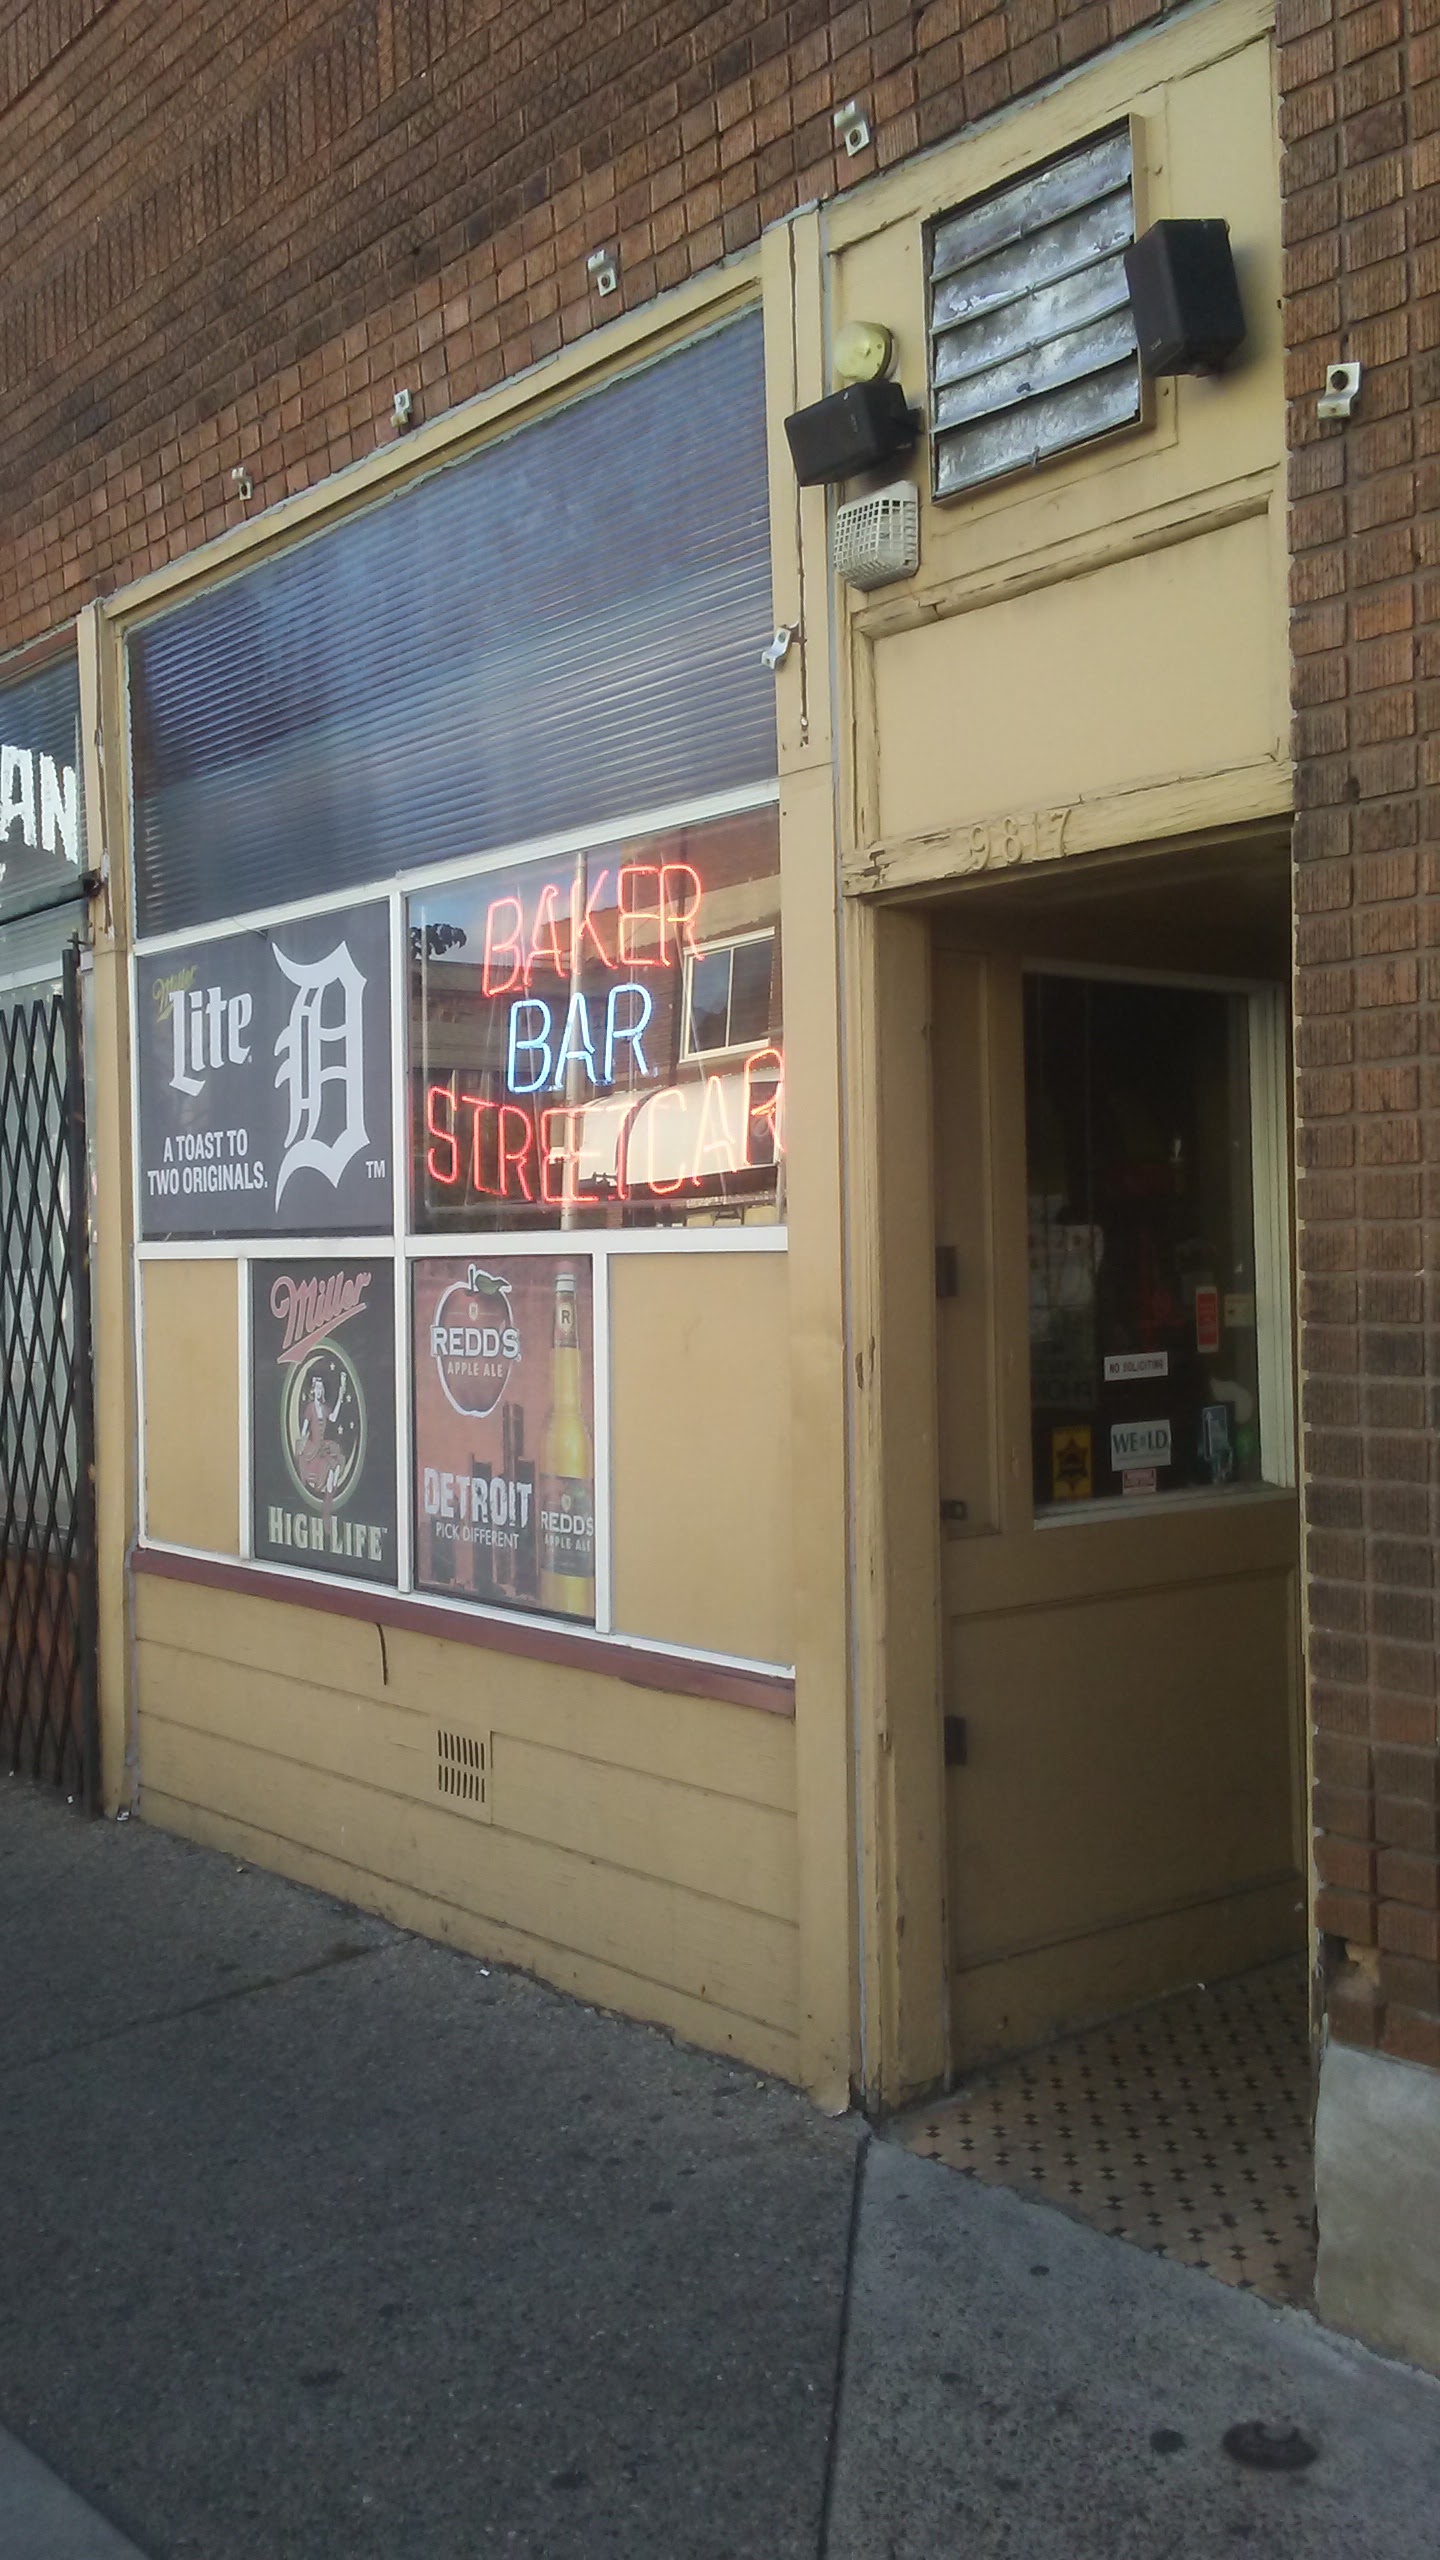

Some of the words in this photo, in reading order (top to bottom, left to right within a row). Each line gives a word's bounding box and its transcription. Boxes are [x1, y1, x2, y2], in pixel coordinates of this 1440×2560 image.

[968, 808, 1072, 871] 9817
[482, 863, 706, 997] BAKER
[168, 986, 253, 1097] Lite
[506, 982, 655, 1093] BAR
[427, 1047, 785, 1203] STREETCAR
[163, 1136, 174, 1163] A
[175, 1131, 224, 1161] TOAST
[226, 1128, 248, 1157] TO
[147, 1168, 179, 1195] TWO
[182, 1160, 268, 1194] ORIGINALS.
[366, 1160, 386, 1178] TM
[270, 1270, 372, 1350] Miller
[561, 1310, 571, 1324] R
[447, 1361, 479, 1377] APPLE
[483, 1363, 503, 1378] ALE
[1109, 1362, 1120, 1374] NO
[1122, 1359, 1164, 1372] SOLICITING
[1113, 1432, 1138, 1454] WE
[424, 1467, 533, 1528] DETROIT
[268, 1505, 324, 1551] HIGH
[435, 1521, 460, 1541] PICK
[463, 1525, 520, 1550] DIFFERENT
